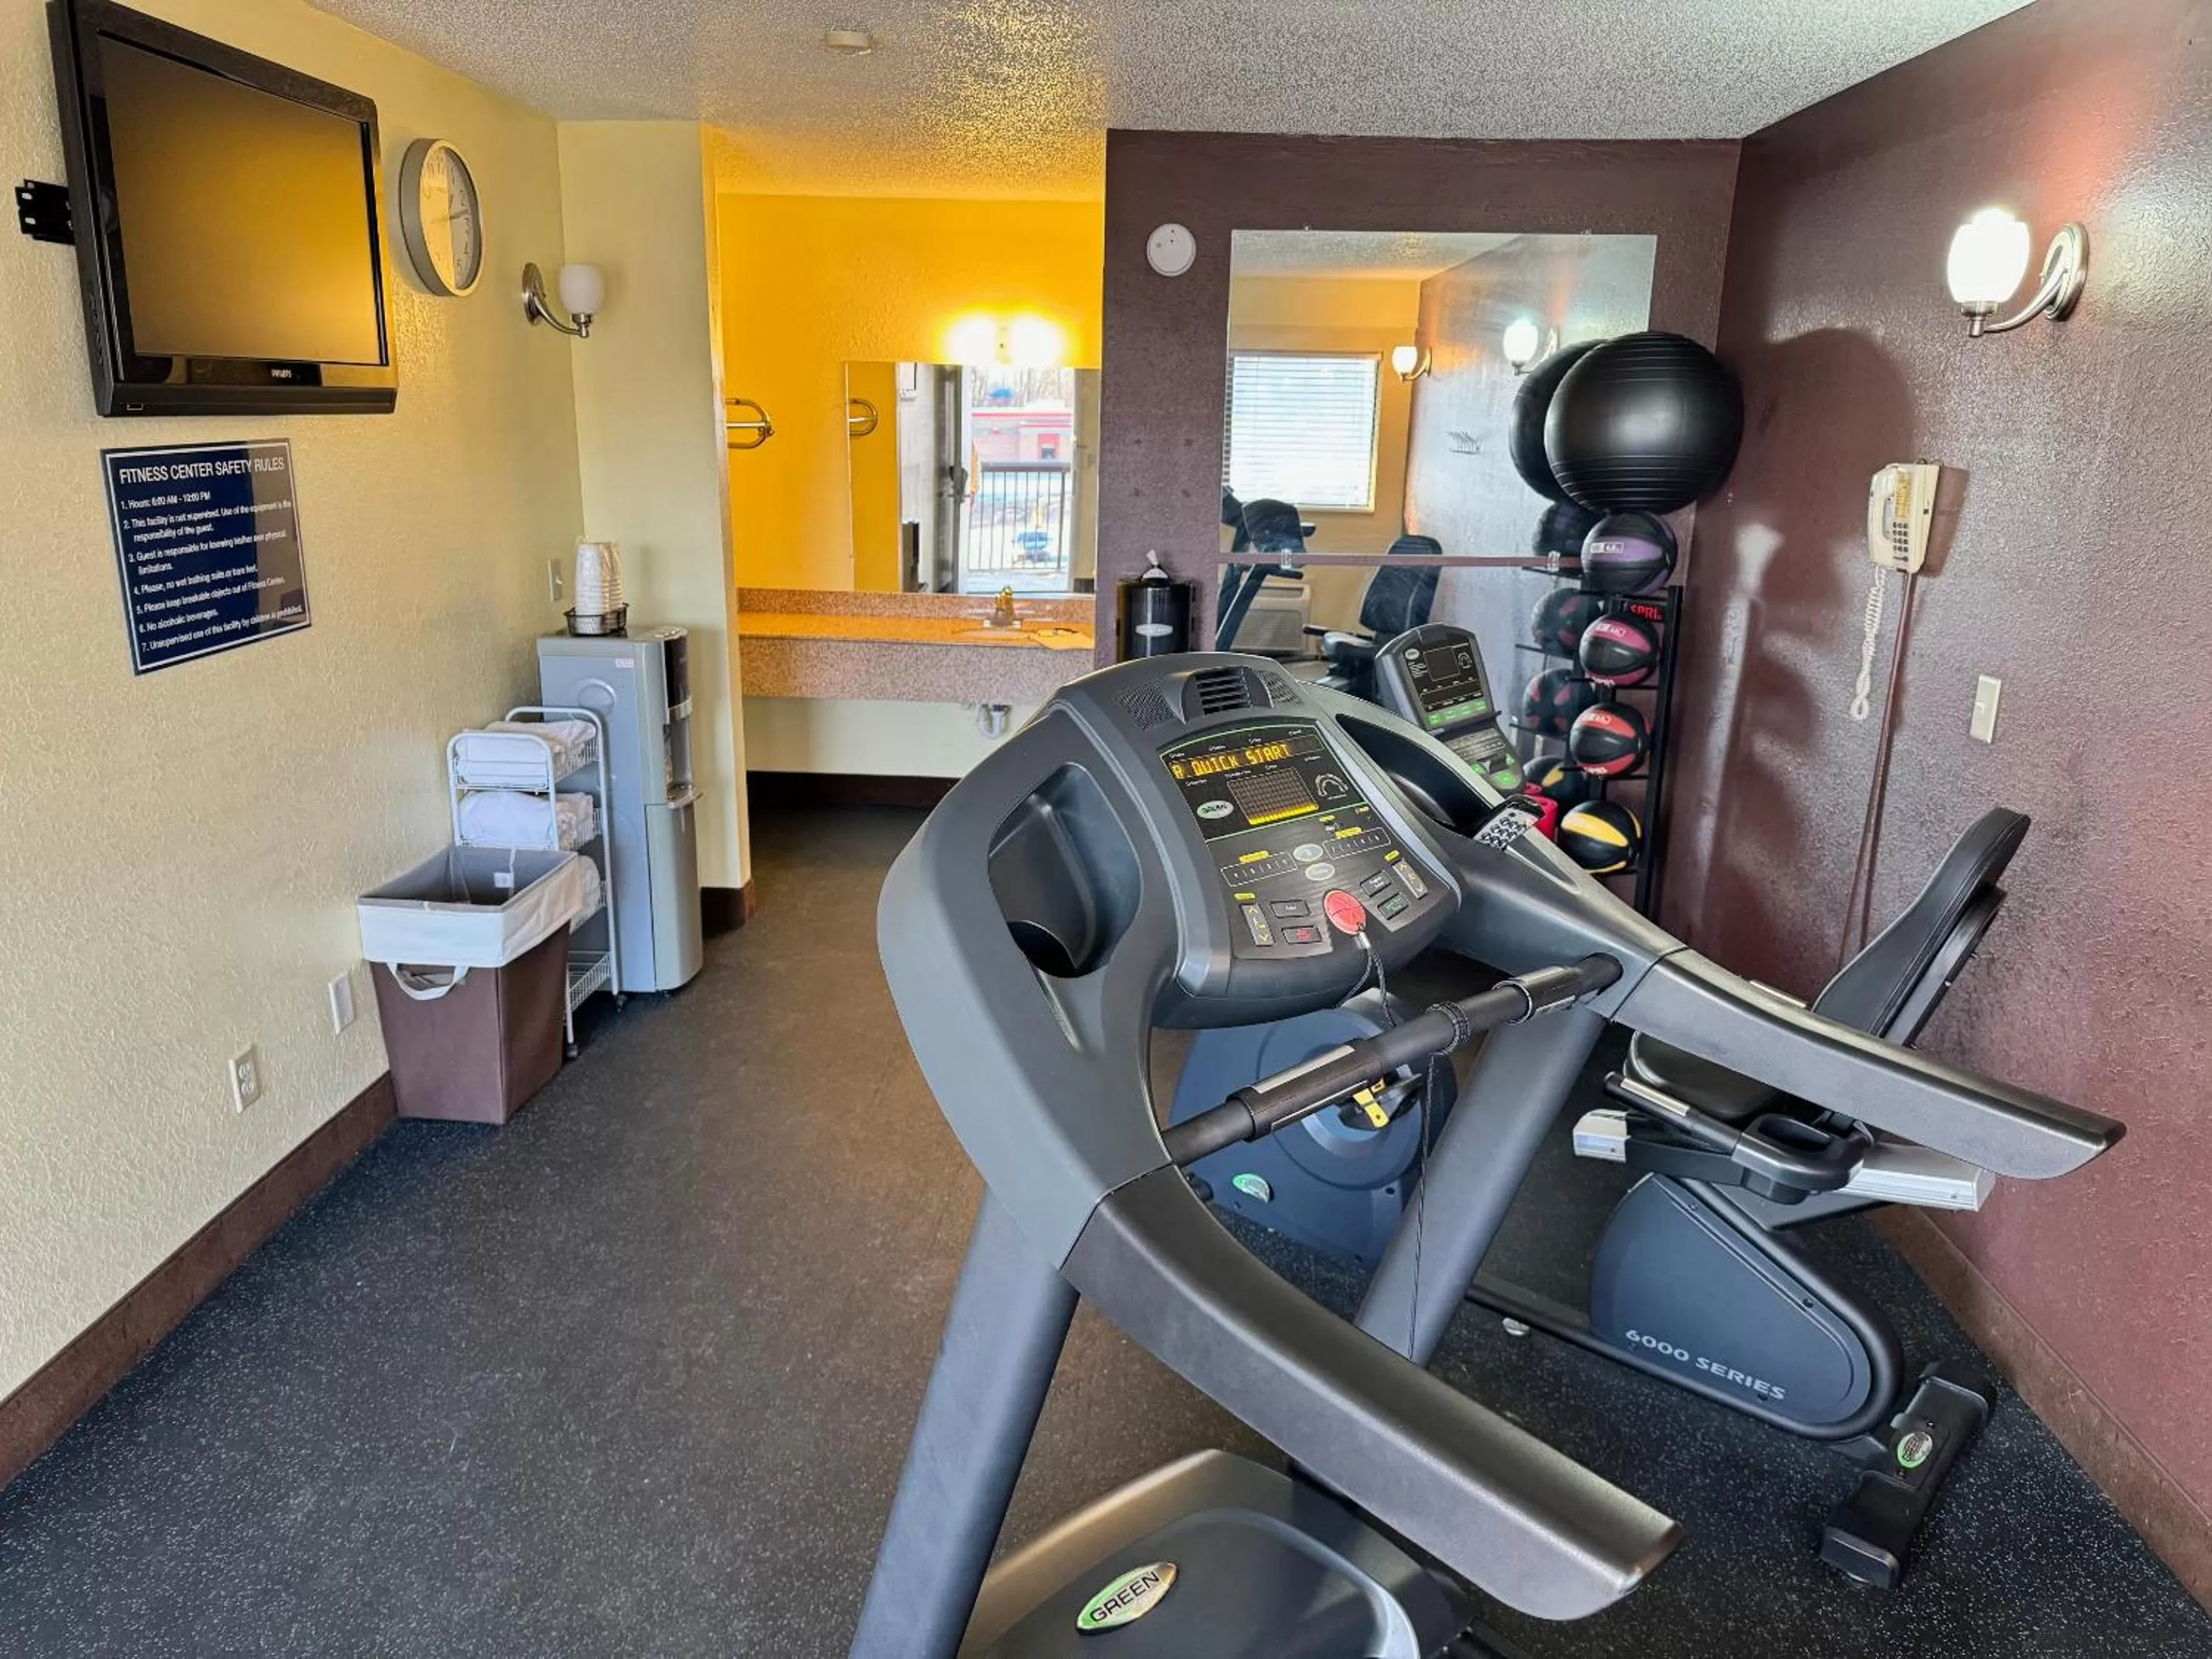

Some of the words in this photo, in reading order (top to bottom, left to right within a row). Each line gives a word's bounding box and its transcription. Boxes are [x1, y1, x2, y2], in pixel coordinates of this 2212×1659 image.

[119, 465, 169, 484] FITNESS
[170, 462, 214, 480] CENTER
[215, 459, 252, 476] SAFETY
[254, 456, 284, 472] RULES
[200, 490, 211, 501] PM
[1191, 755, 1239, 777] QUICK
[1245, 744, 1293, 765] START
[1626, 1329, 1690, 1362] 6000
[1695, 1356, 1785, 1400] SERIES
[1090, 1571, 1159, 1622] GREEN
